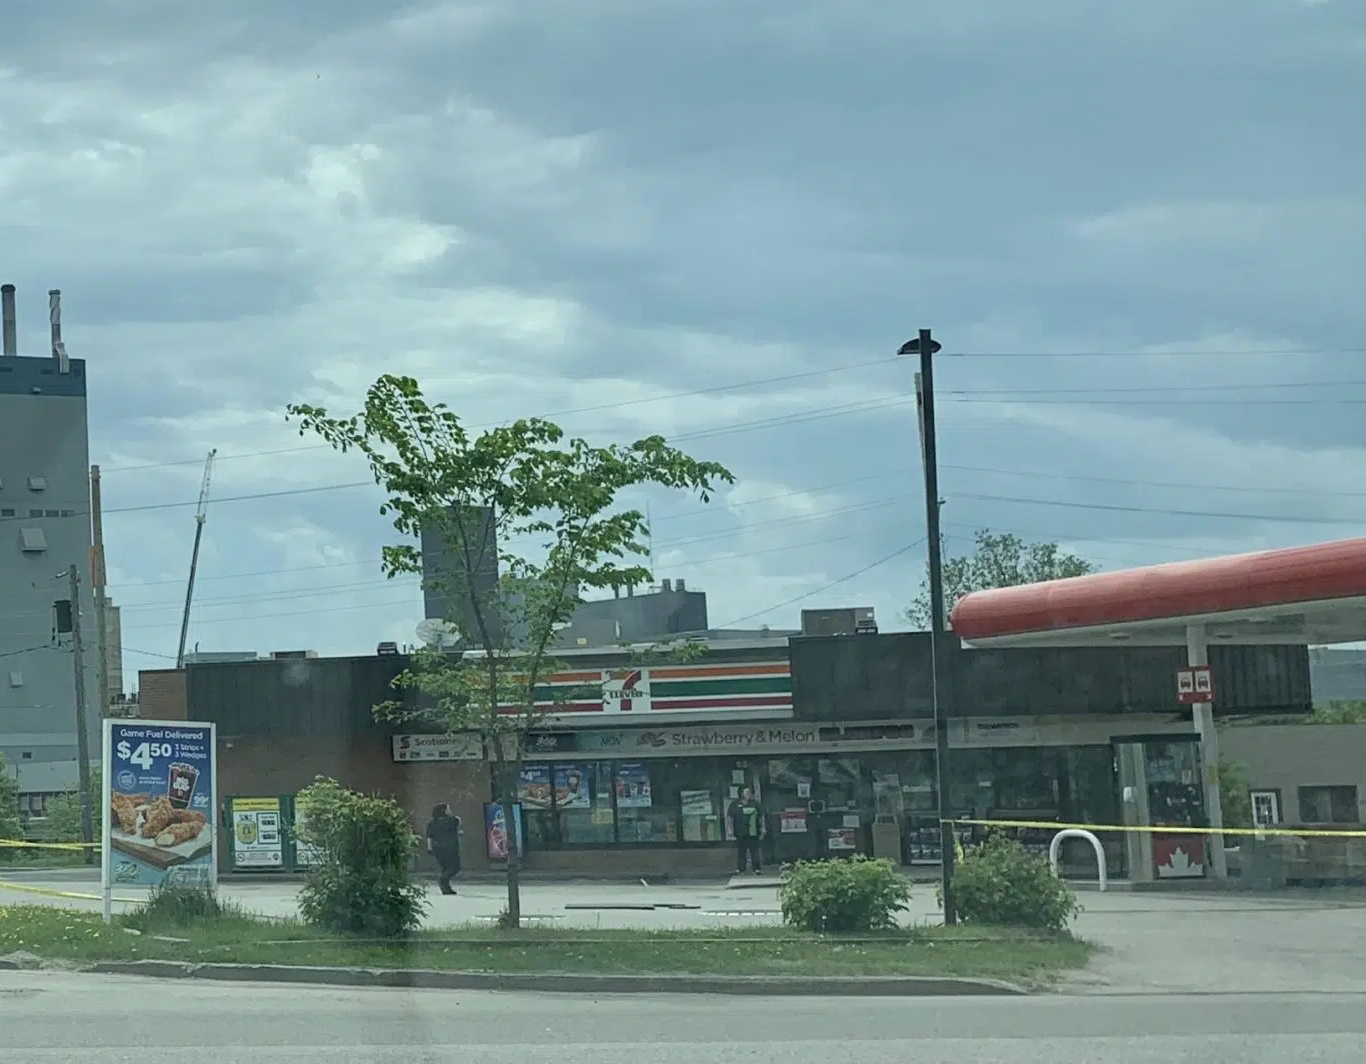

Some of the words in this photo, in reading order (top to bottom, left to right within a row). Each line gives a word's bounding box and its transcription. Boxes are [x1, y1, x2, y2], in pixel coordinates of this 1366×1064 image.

[120, 729, 145, 738] Game
[146, 730, 164, 739] Fuel
[165, 731, 204, 740] Delivered
[672, 731, 753, 746] Strawberry
[756, 730, 768, 743] &
[769, 729, 815, 743] Melon
